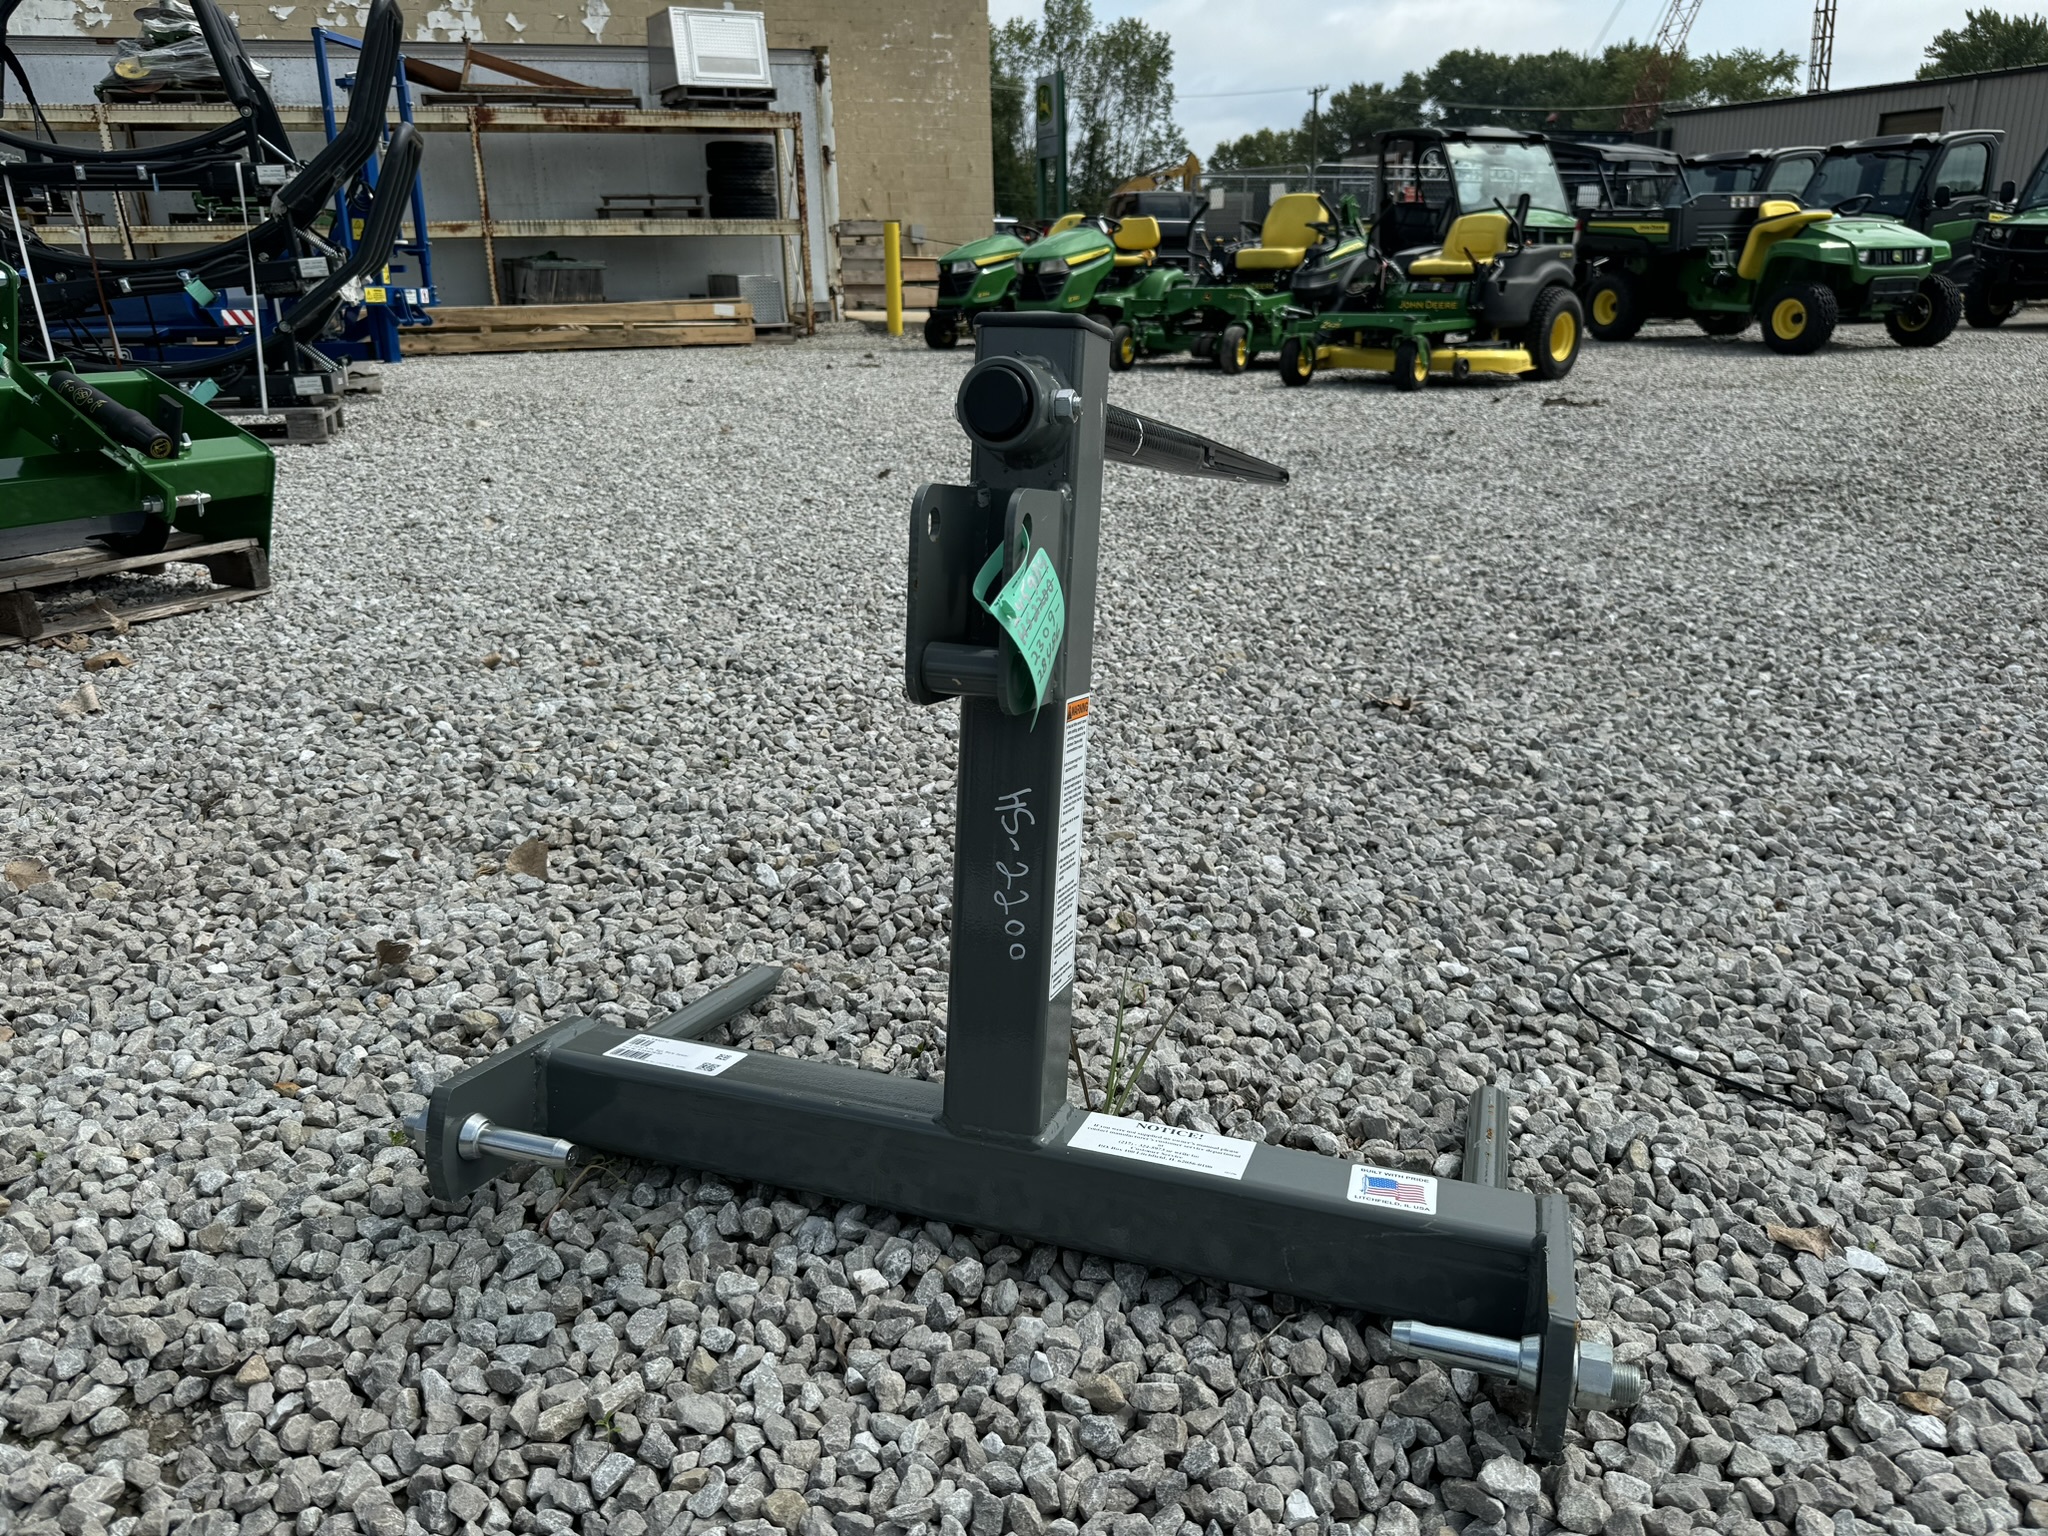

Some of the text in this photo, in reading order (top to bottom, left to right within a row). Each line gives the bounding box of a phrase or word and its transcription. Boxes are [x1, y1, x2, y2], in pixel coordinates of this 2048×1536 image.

[1398, 300, 1457, 310] JOHN DEERE
[1071, 701, 1089, 716] WARNING
[1136, 1122, 1204, 1140] NOTICE!
